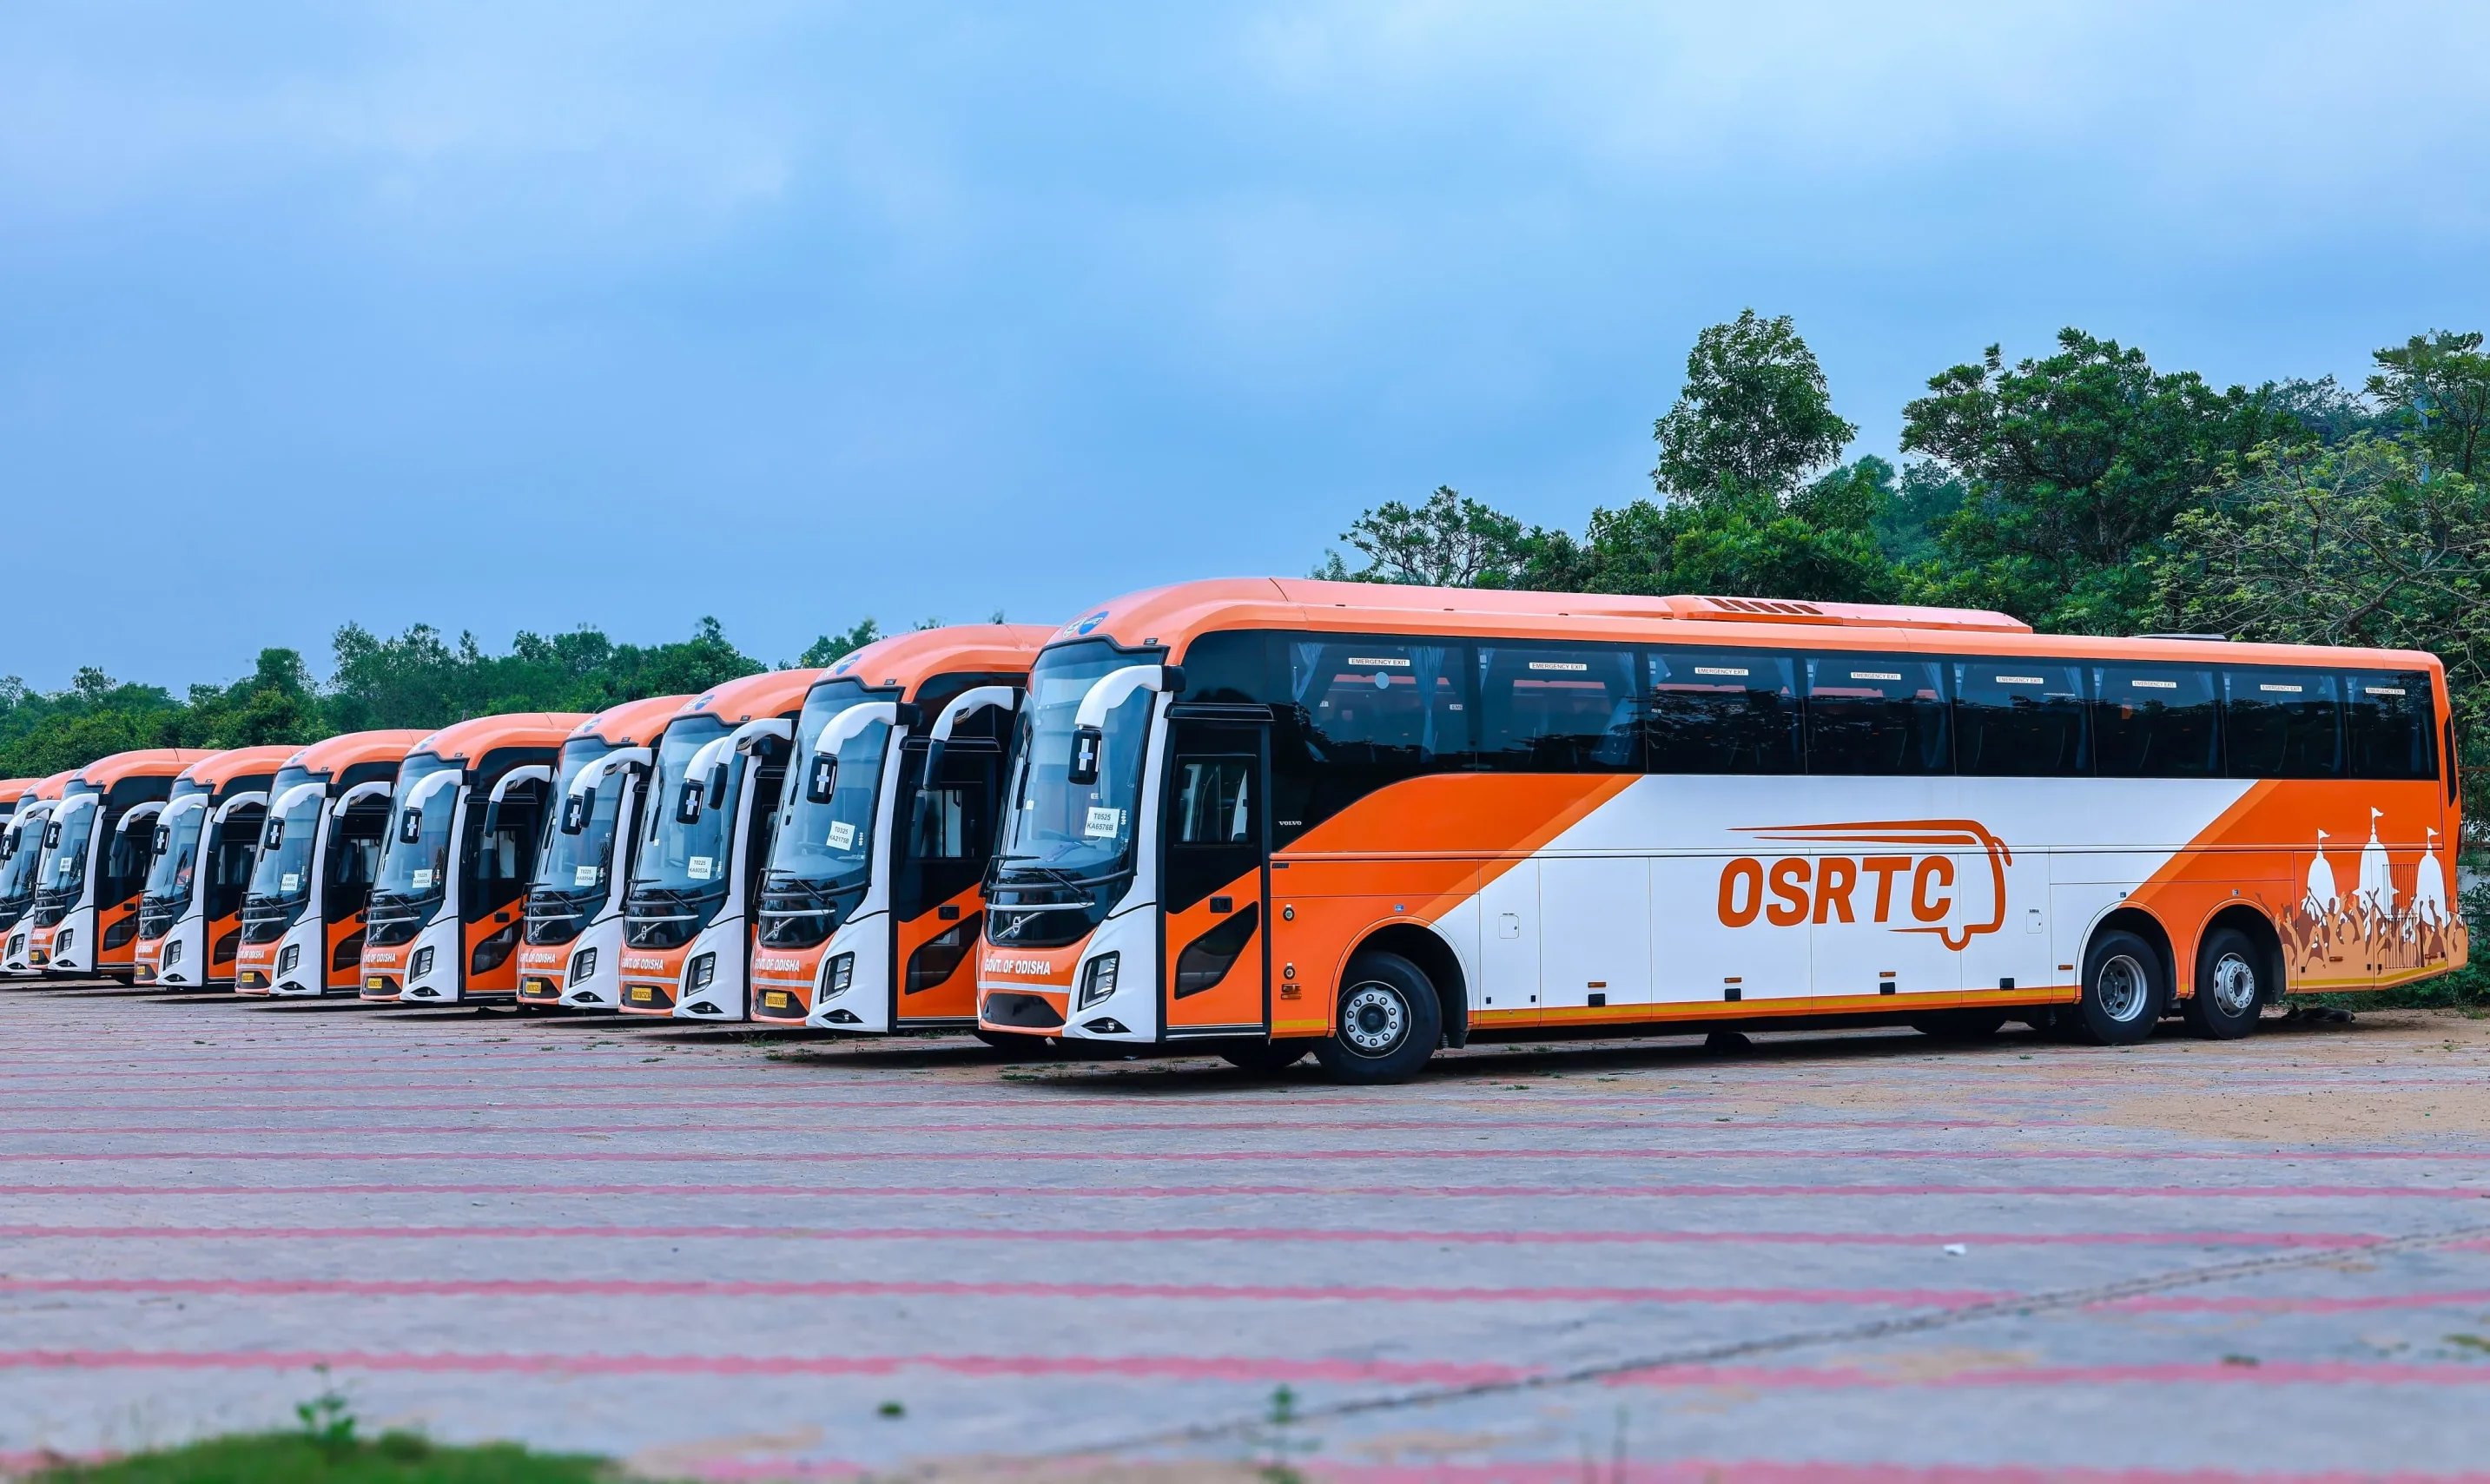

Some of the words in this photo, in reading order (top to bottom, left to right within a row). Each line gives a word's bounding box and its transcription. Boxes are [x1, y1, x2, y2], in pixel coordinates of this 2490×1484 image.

[835, 826, 849, 834] T0325
[1086, 822, 1113, 831] KA6576B
[1717, 855, 1954, 929] OSRTC
[377, 953, 396, 963] ODISHA
[536, 953, 556, 964] ODISHA
[632, 958, 641, 970] OF
[641, 958, 664, 971] ODISHA
[766, 958, 775, 971] OF
[775, 958, 800, 973] ODISHA
[984, 959, 1001, 973] GOVT.
[1003, 960, 1014, 973] OF
[1015, 960, 1051, 975] ODISHA
